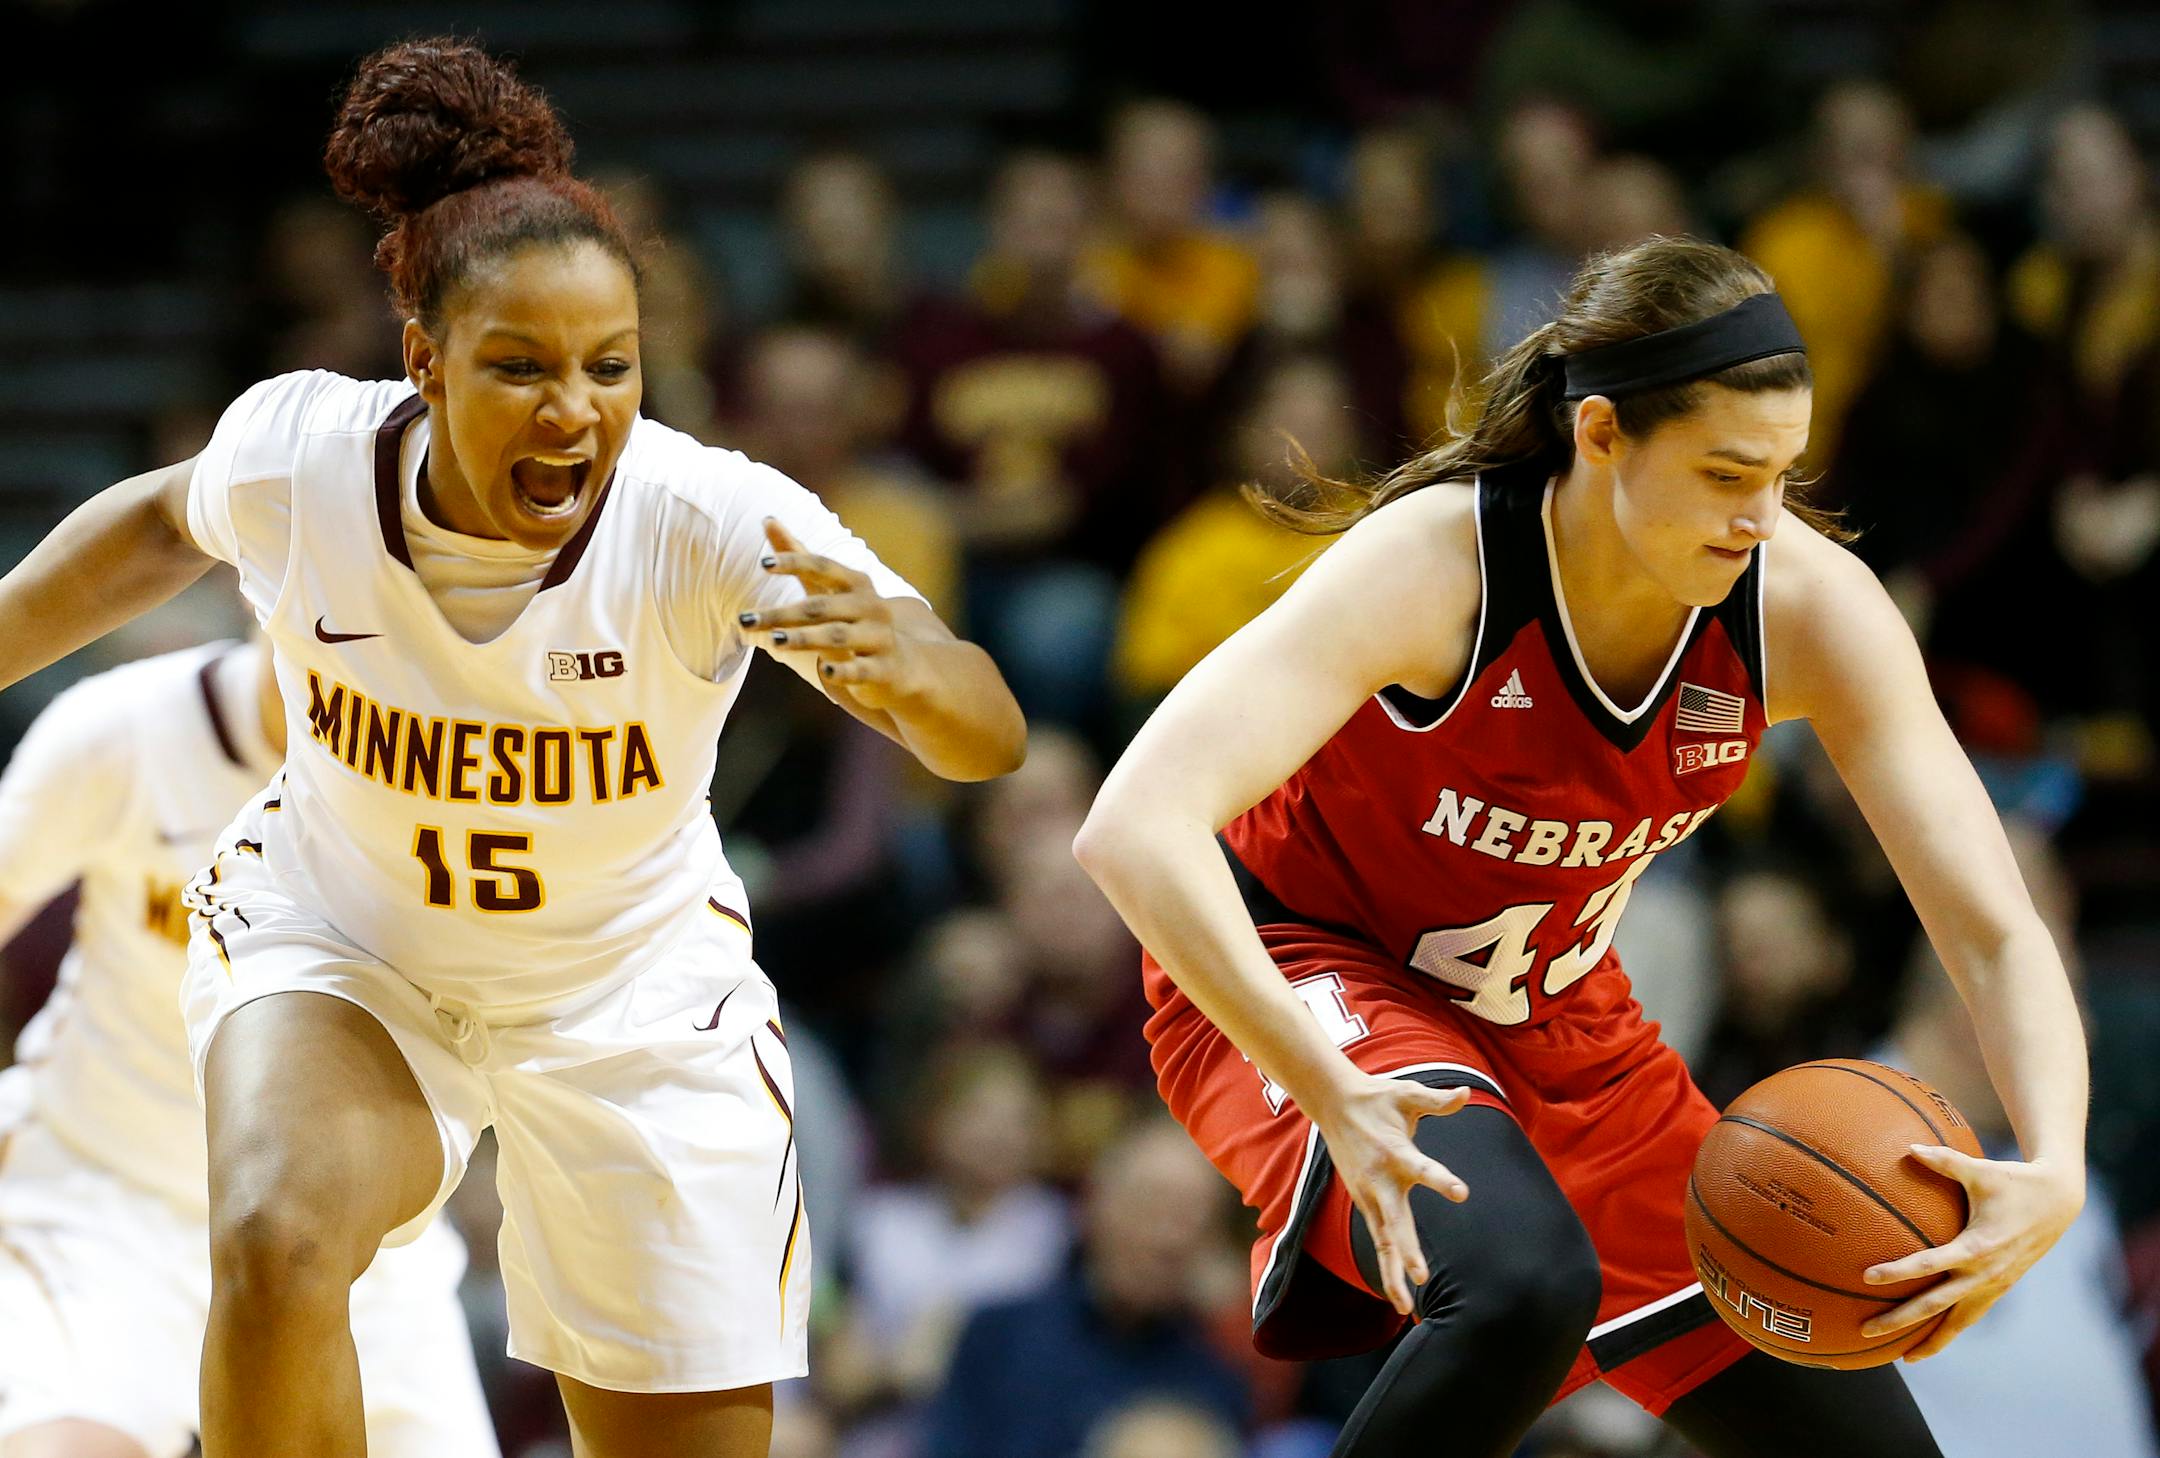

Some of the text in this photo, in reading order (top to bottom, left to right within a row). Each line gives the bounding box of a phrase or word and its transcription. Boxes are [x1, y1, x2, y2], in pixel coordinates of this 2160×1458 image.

[306, 667, 665, 807] MINNESOTA
[1490, 693, 1534, 709] adidas
[411, 823, 547, 914] 15
[1408, 852, 1657, 1026] 43
[1698, 1250, 1811, 1343] ELITE
